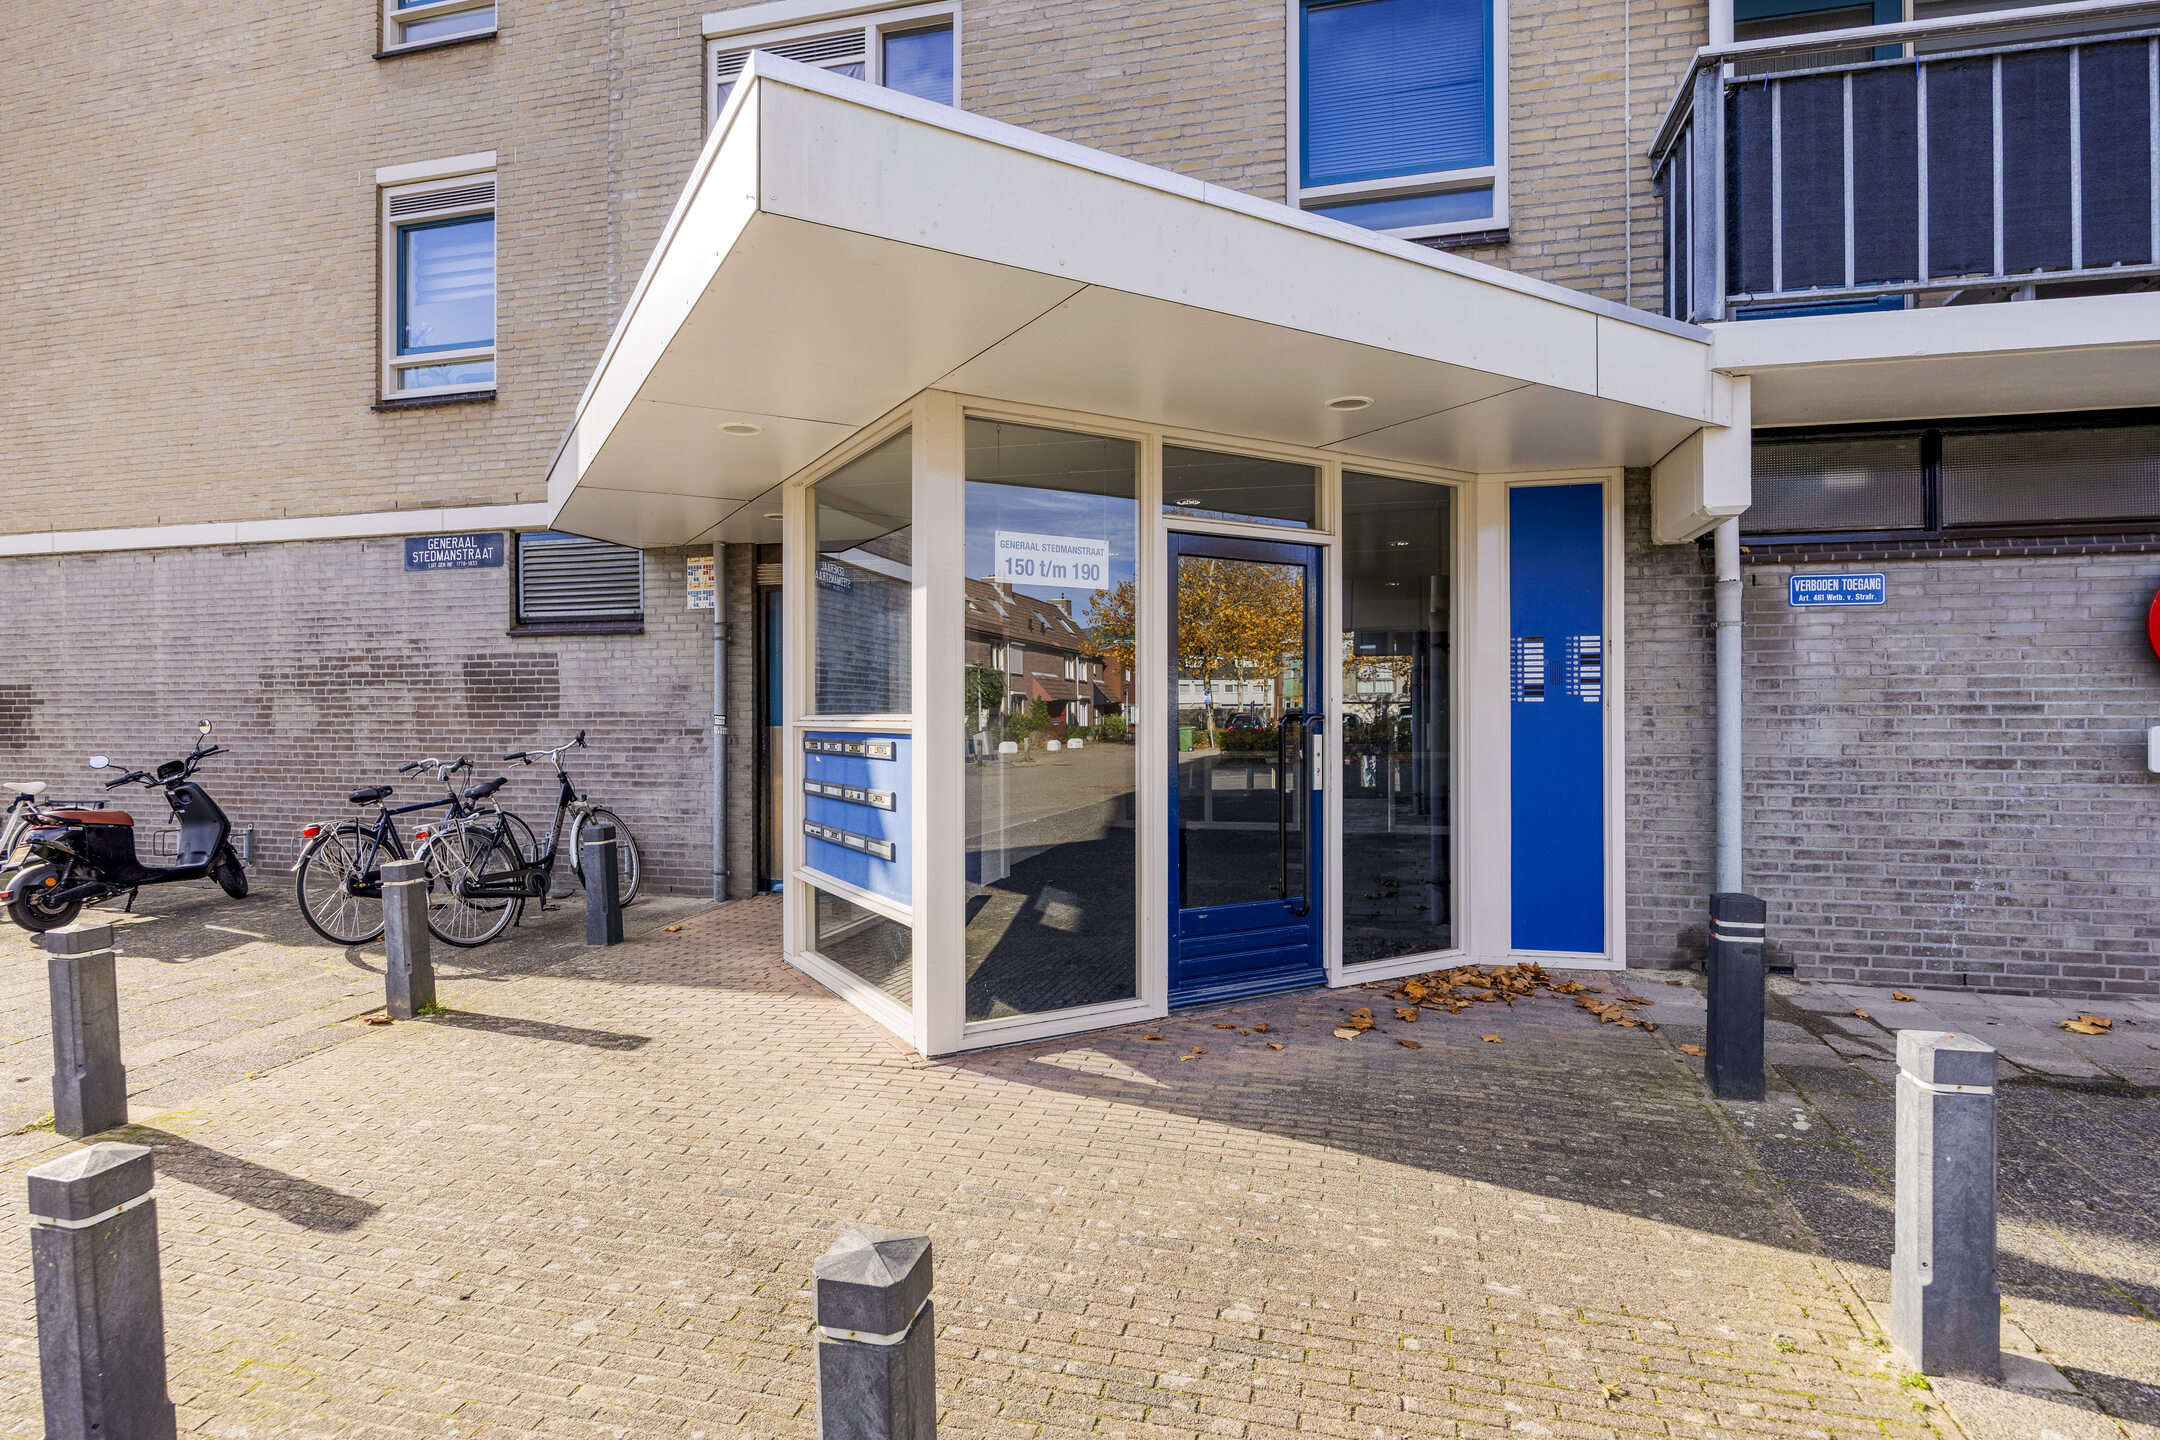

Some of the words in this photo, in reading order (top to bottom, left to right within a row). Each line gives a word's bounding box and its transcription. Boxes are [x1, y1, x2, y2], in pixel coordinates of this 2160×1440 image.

[427, 536, 478, 550] GENERAAL
[1000, 539, 1040, 552] GENERAAL
[1041, 543, 1105, 556] STEDMANSTRAAT
[412, 547, 494, 563] STEDMANSTRAAT
[1005, 557, 1035, 577] 150
[1039, 560, 1067, 579] t/m
[1072, 562, 1100, 581] 190
[1794, 579, 1839, 592] VERBODEN
[1841, 577, 1881, 591] TOEGANG
[1798, 594, 1811, 602] Art.
[1826, 593, 1845, 601] Wetb.
[1855, 593, 1877, 601] Strafr.
